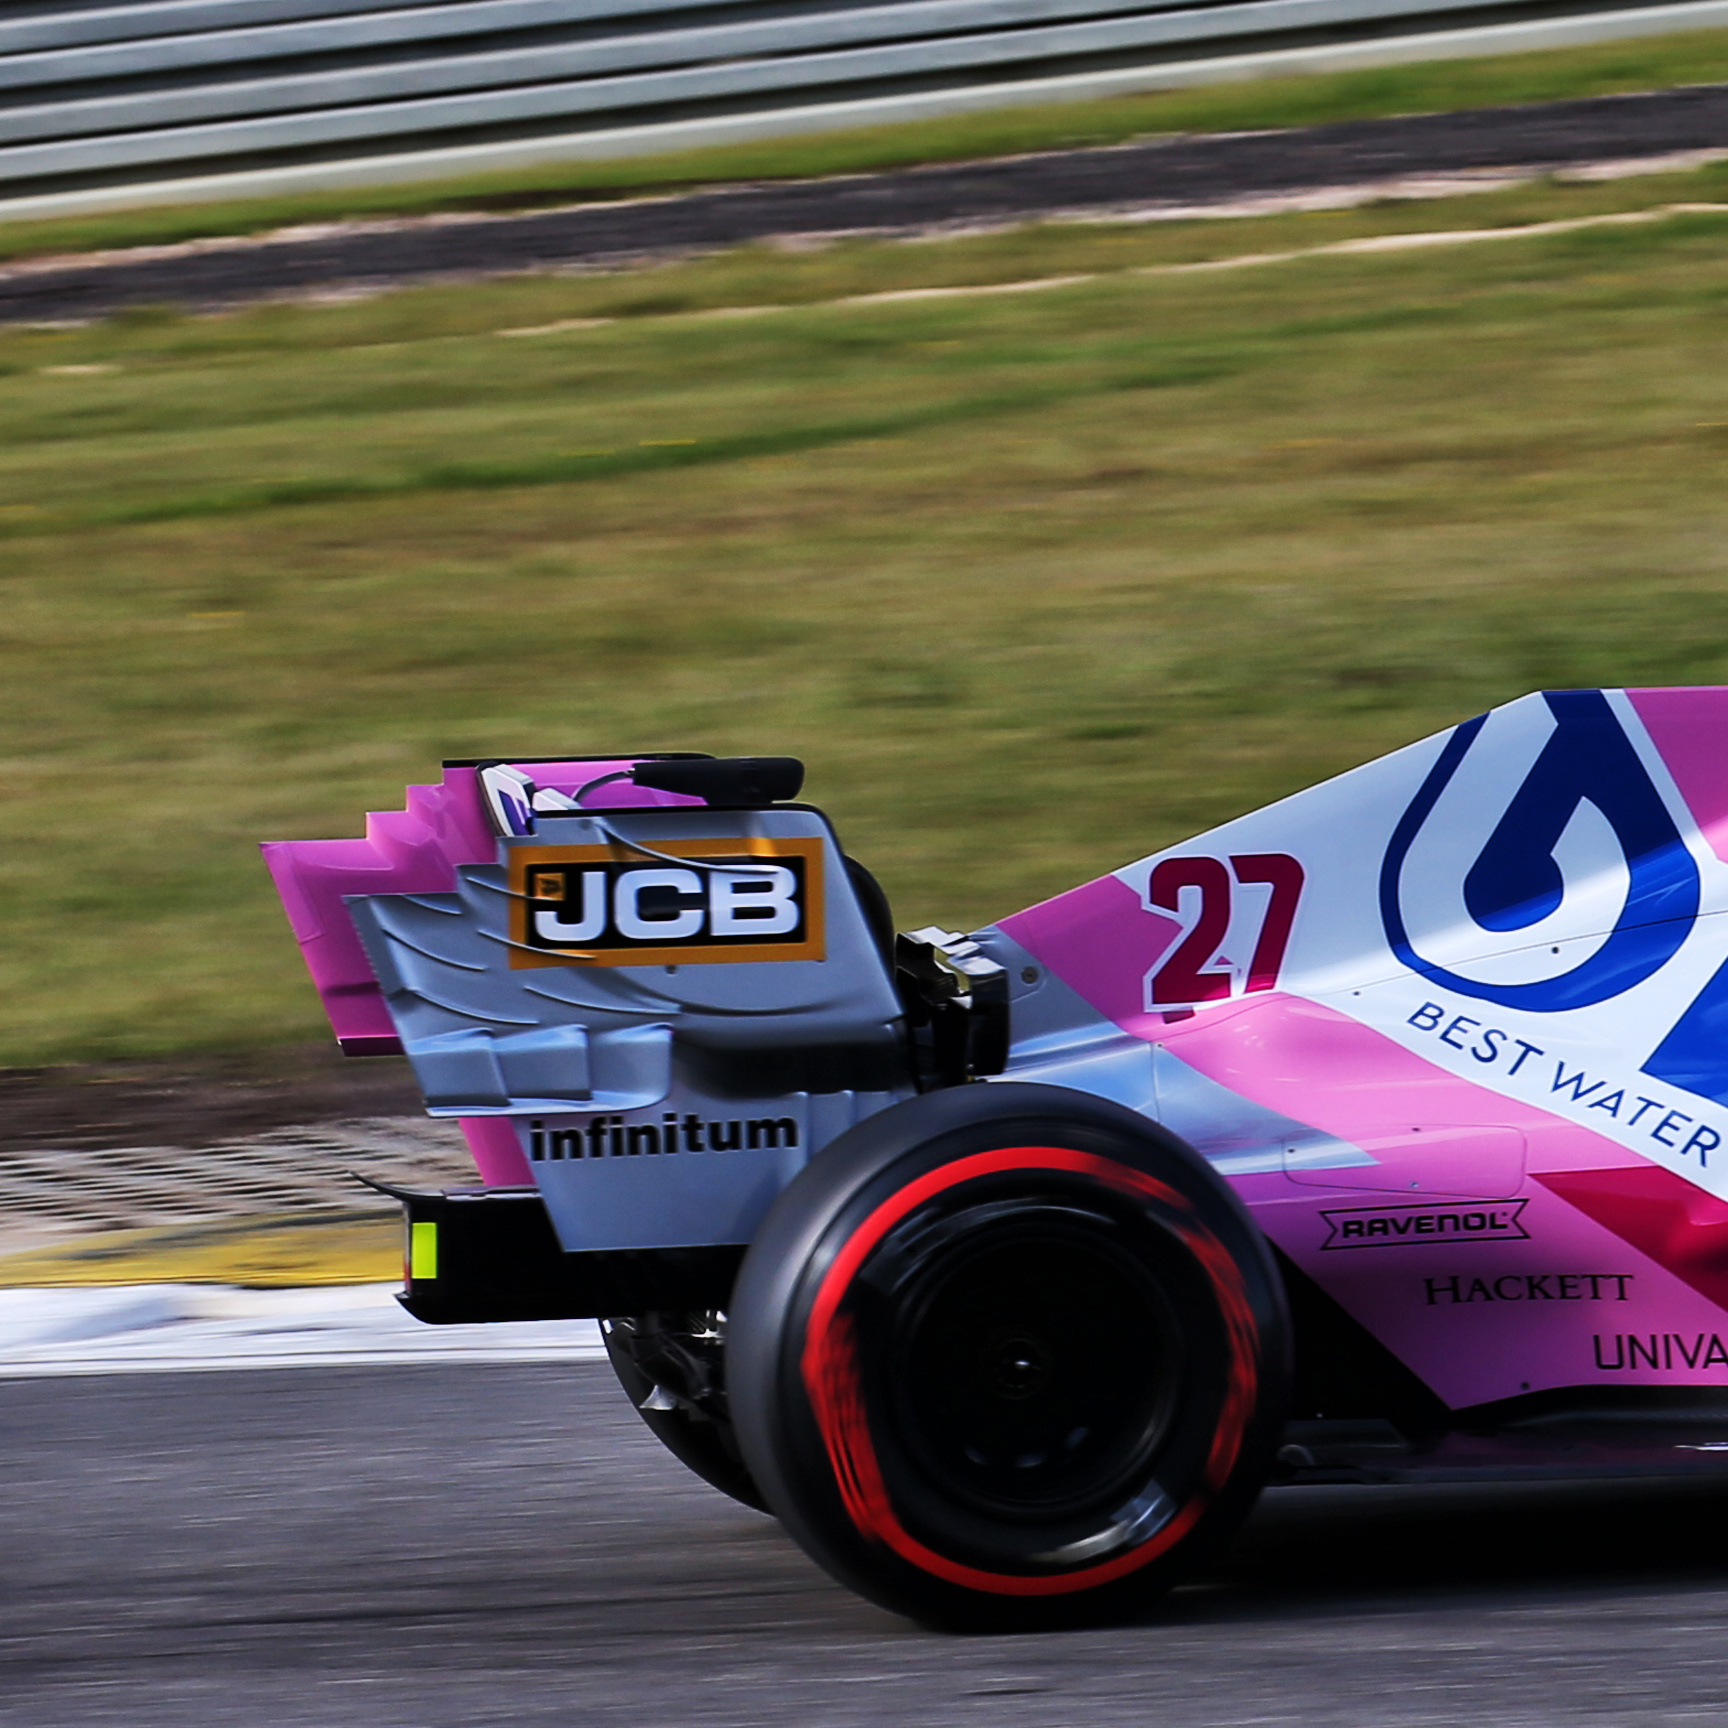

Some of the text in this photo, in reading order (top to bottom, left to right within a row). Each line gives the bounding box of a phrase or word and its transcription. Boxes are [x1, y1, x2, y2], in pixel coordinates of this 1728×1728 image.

[534, 864, 800, 942] JCB
[1150, 853, 1305, 1005] 27
[1406, 1001, 1544, 1076] BEST
[1550, 1060, 1721, 1167] WATER
[530, 1112, 798, 1161] infinitum
[1341, 1211, 1509, 1239] RAVENOL
[1423, 1274, 1634, 1306] HACKETT
